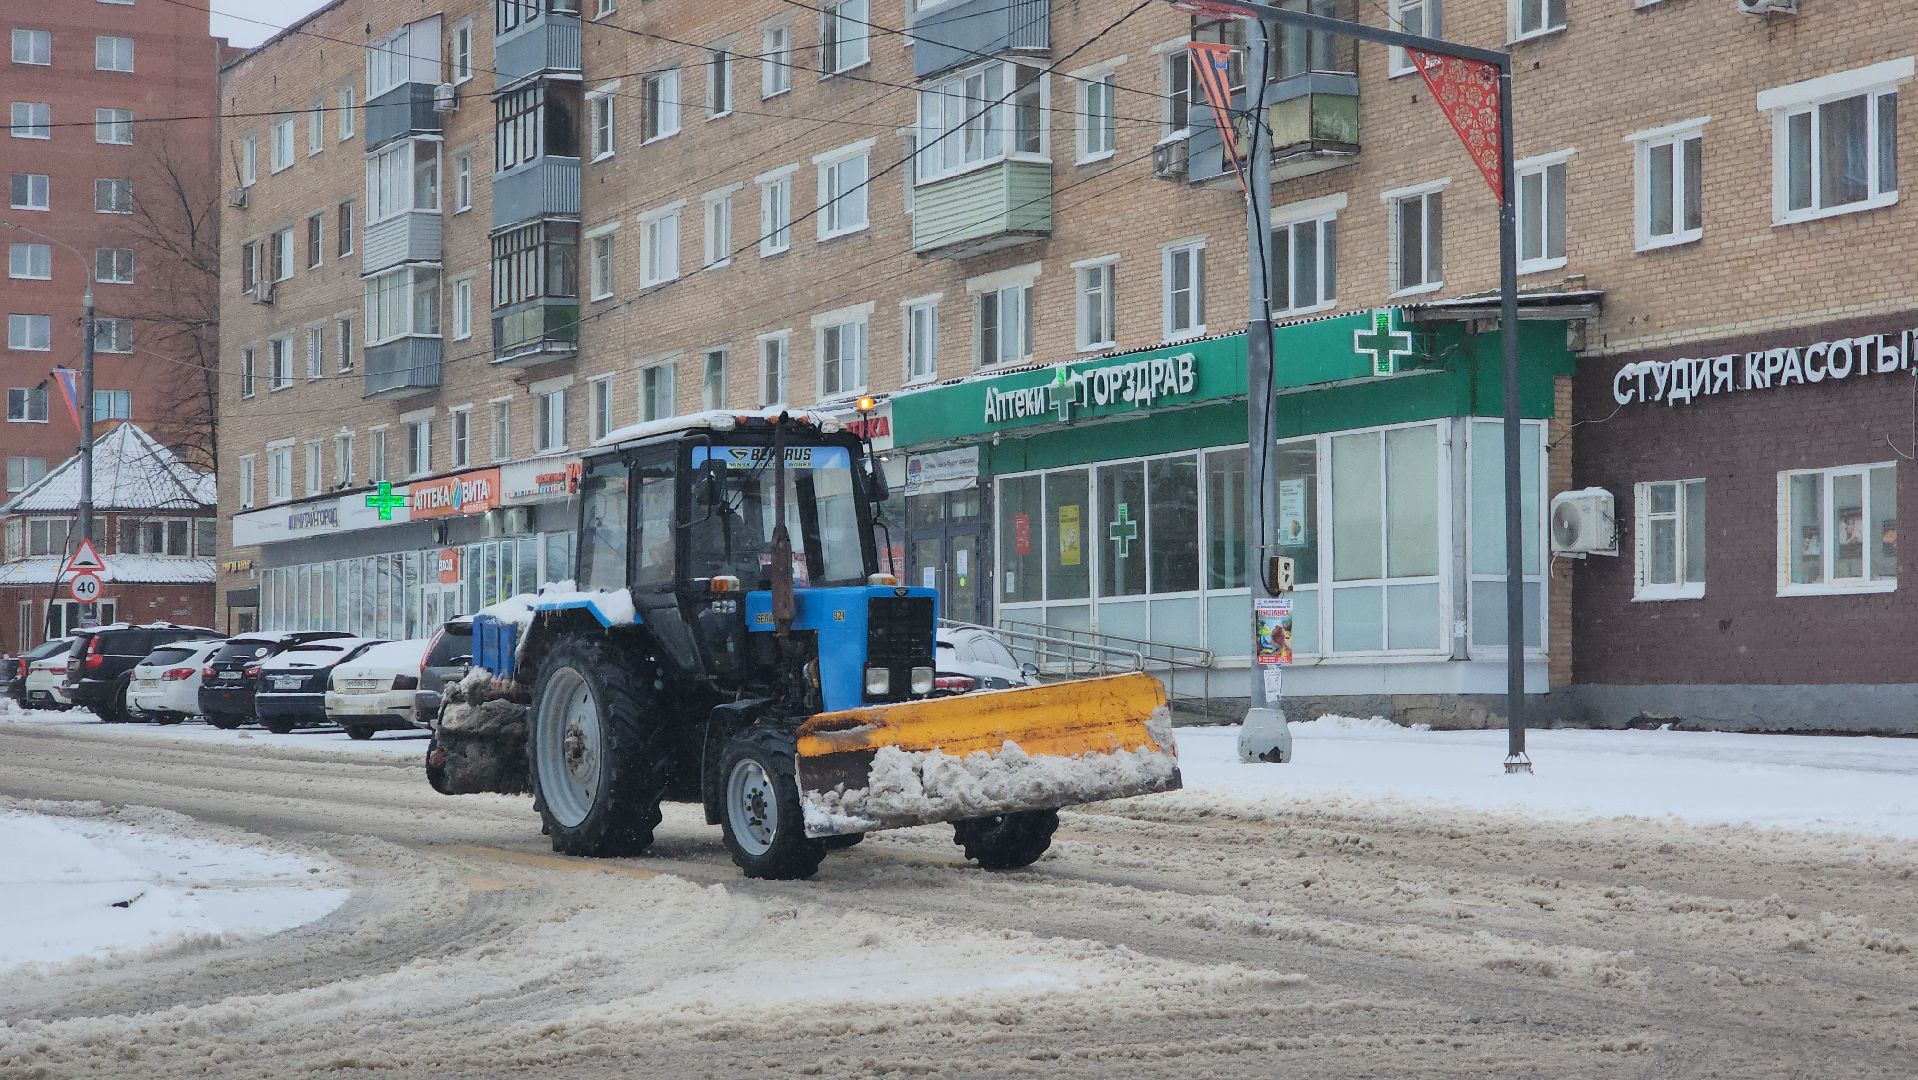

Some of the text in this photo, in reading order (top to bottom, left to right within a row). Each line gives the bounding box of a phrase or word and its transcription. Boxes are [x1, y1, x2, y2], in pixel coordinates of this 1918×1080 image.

[984, 354, 1194, 424] Аптеки ГОРЗДРАВ
[1613, 331, 1908, 407] СТУДИЯ КРАСОТЫ
[413, 478, 489, 512] АПТЕКА ВИТА
[77, 582, 95, 594] 40
